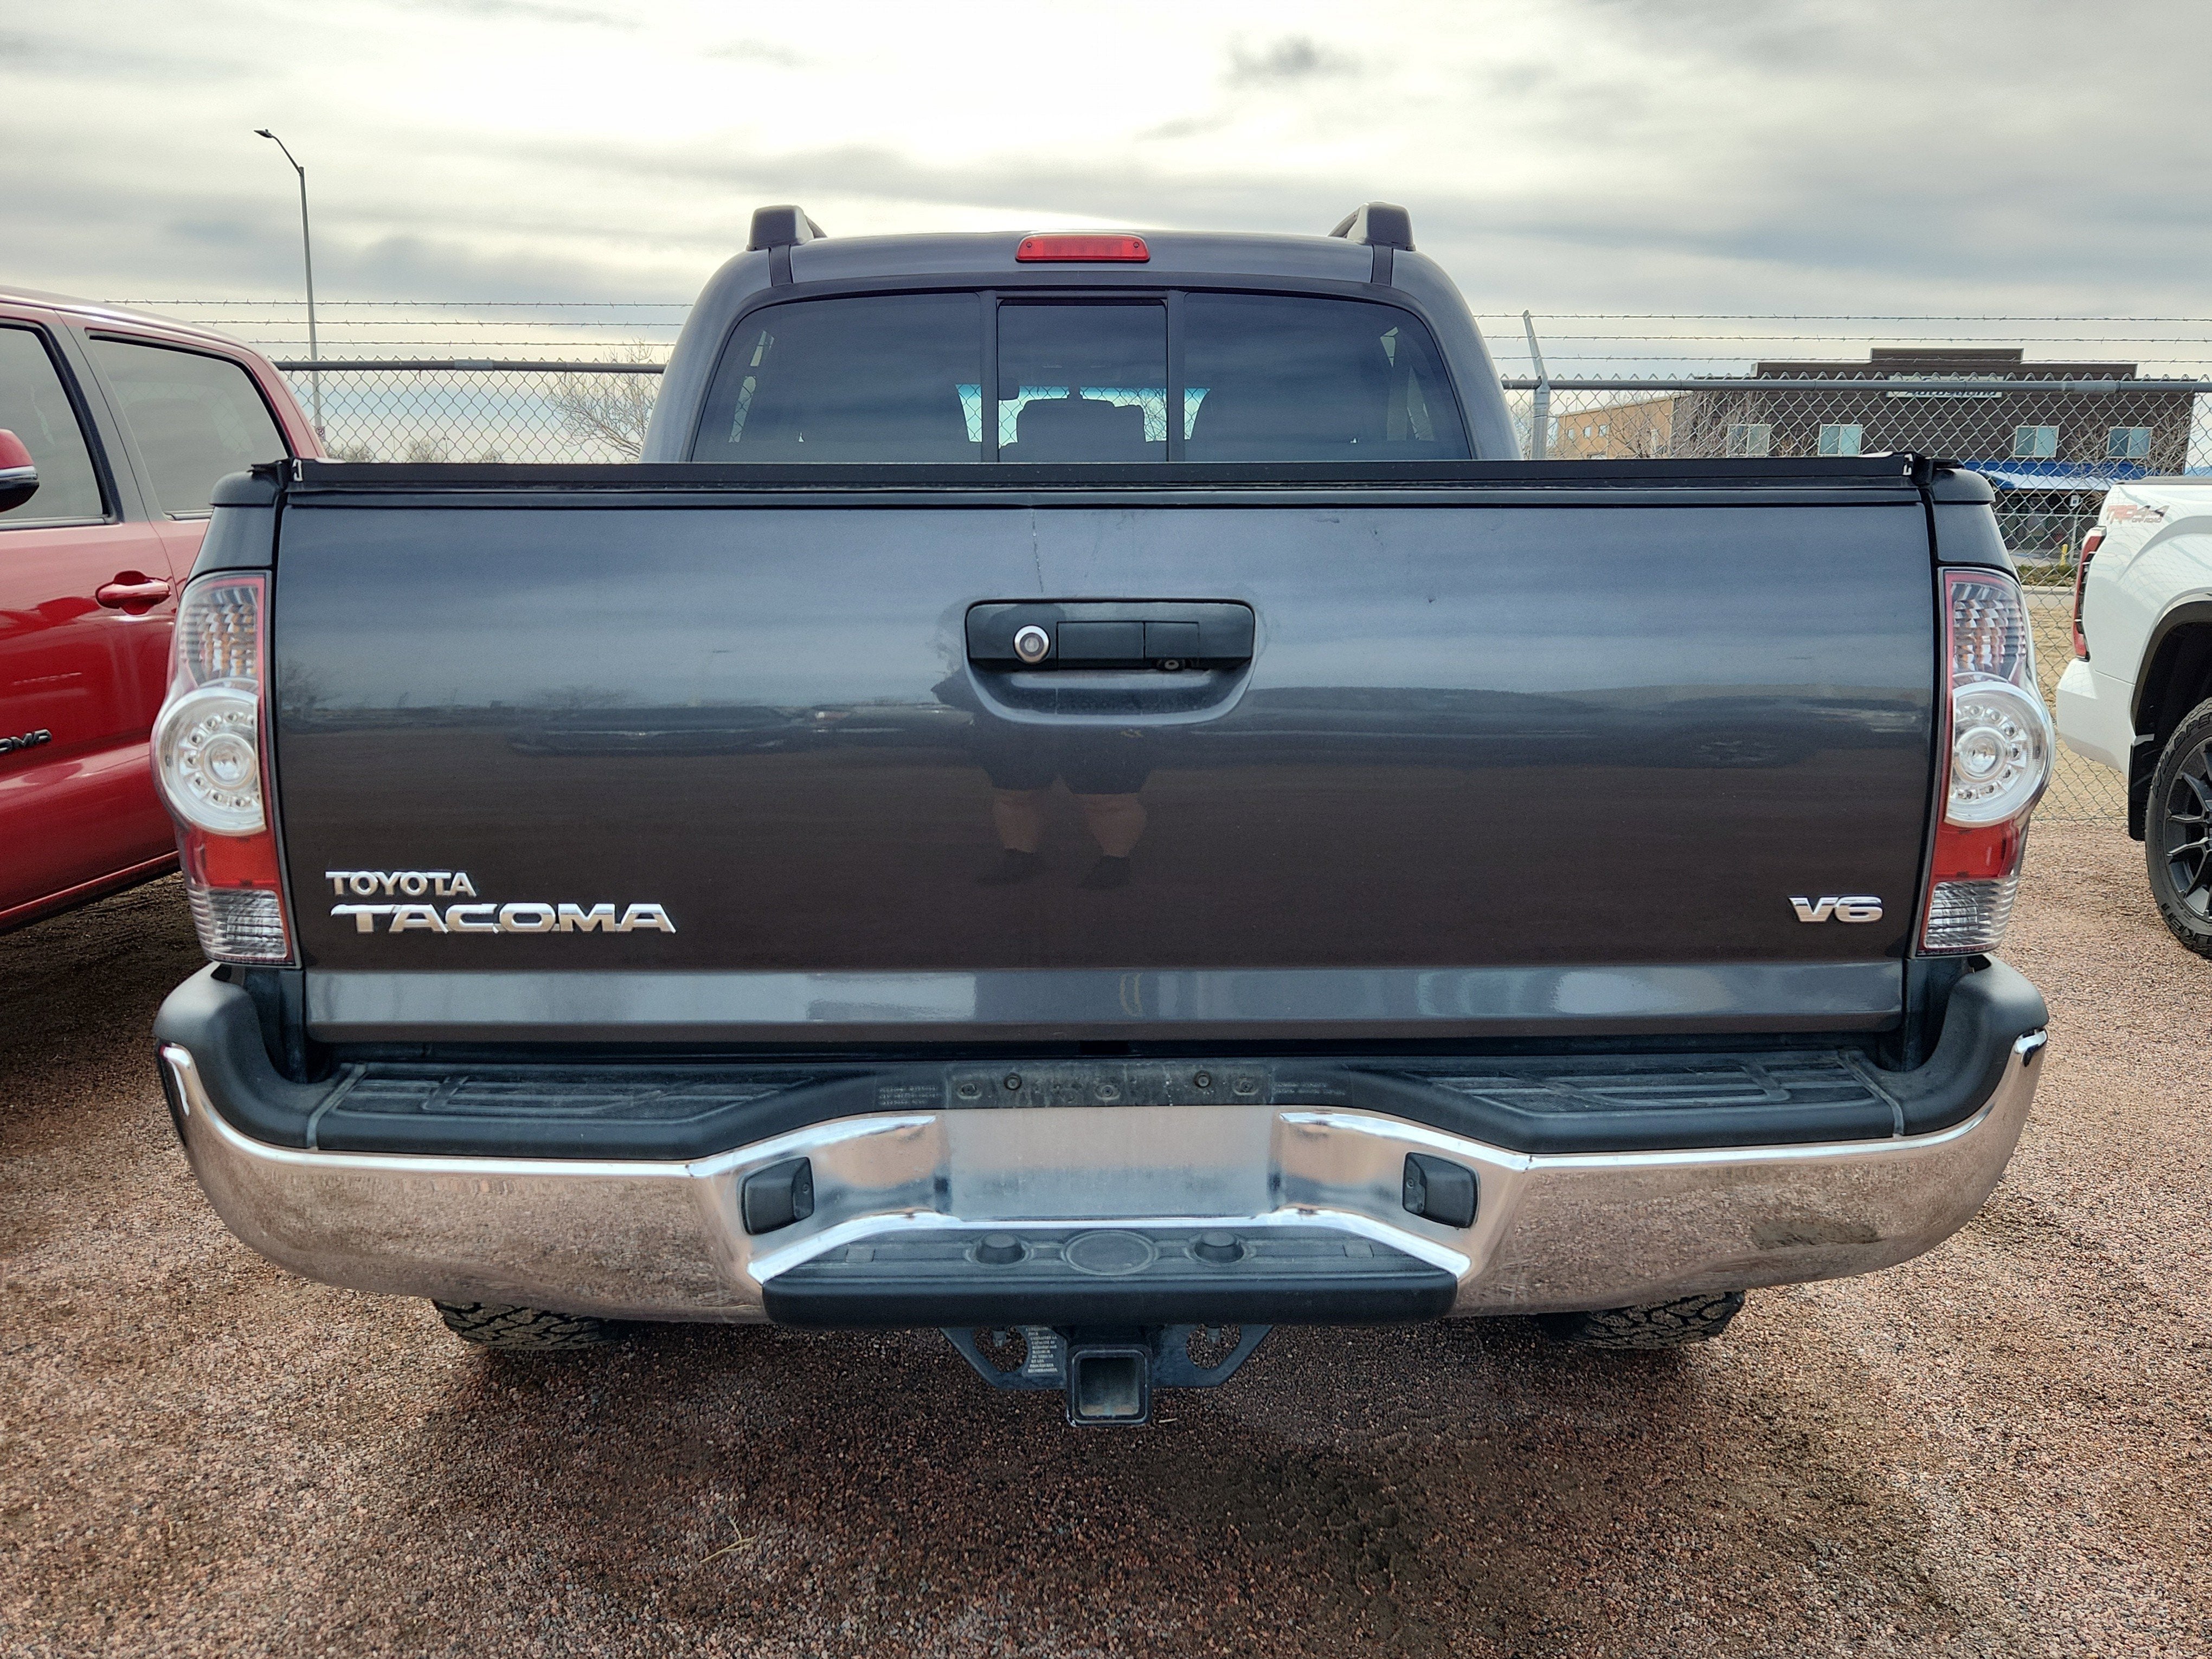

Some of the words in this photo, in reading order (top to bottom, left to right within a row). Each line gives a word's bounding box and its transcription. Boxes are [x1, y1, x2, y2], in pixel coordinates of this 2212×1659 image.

[2106, 505, 2137, 524] TRD
[325, 871, 477, 897] TOYOTA
[330, 903, 677, 934] TACOMA
[1789, 896, 1883, 923] V6
